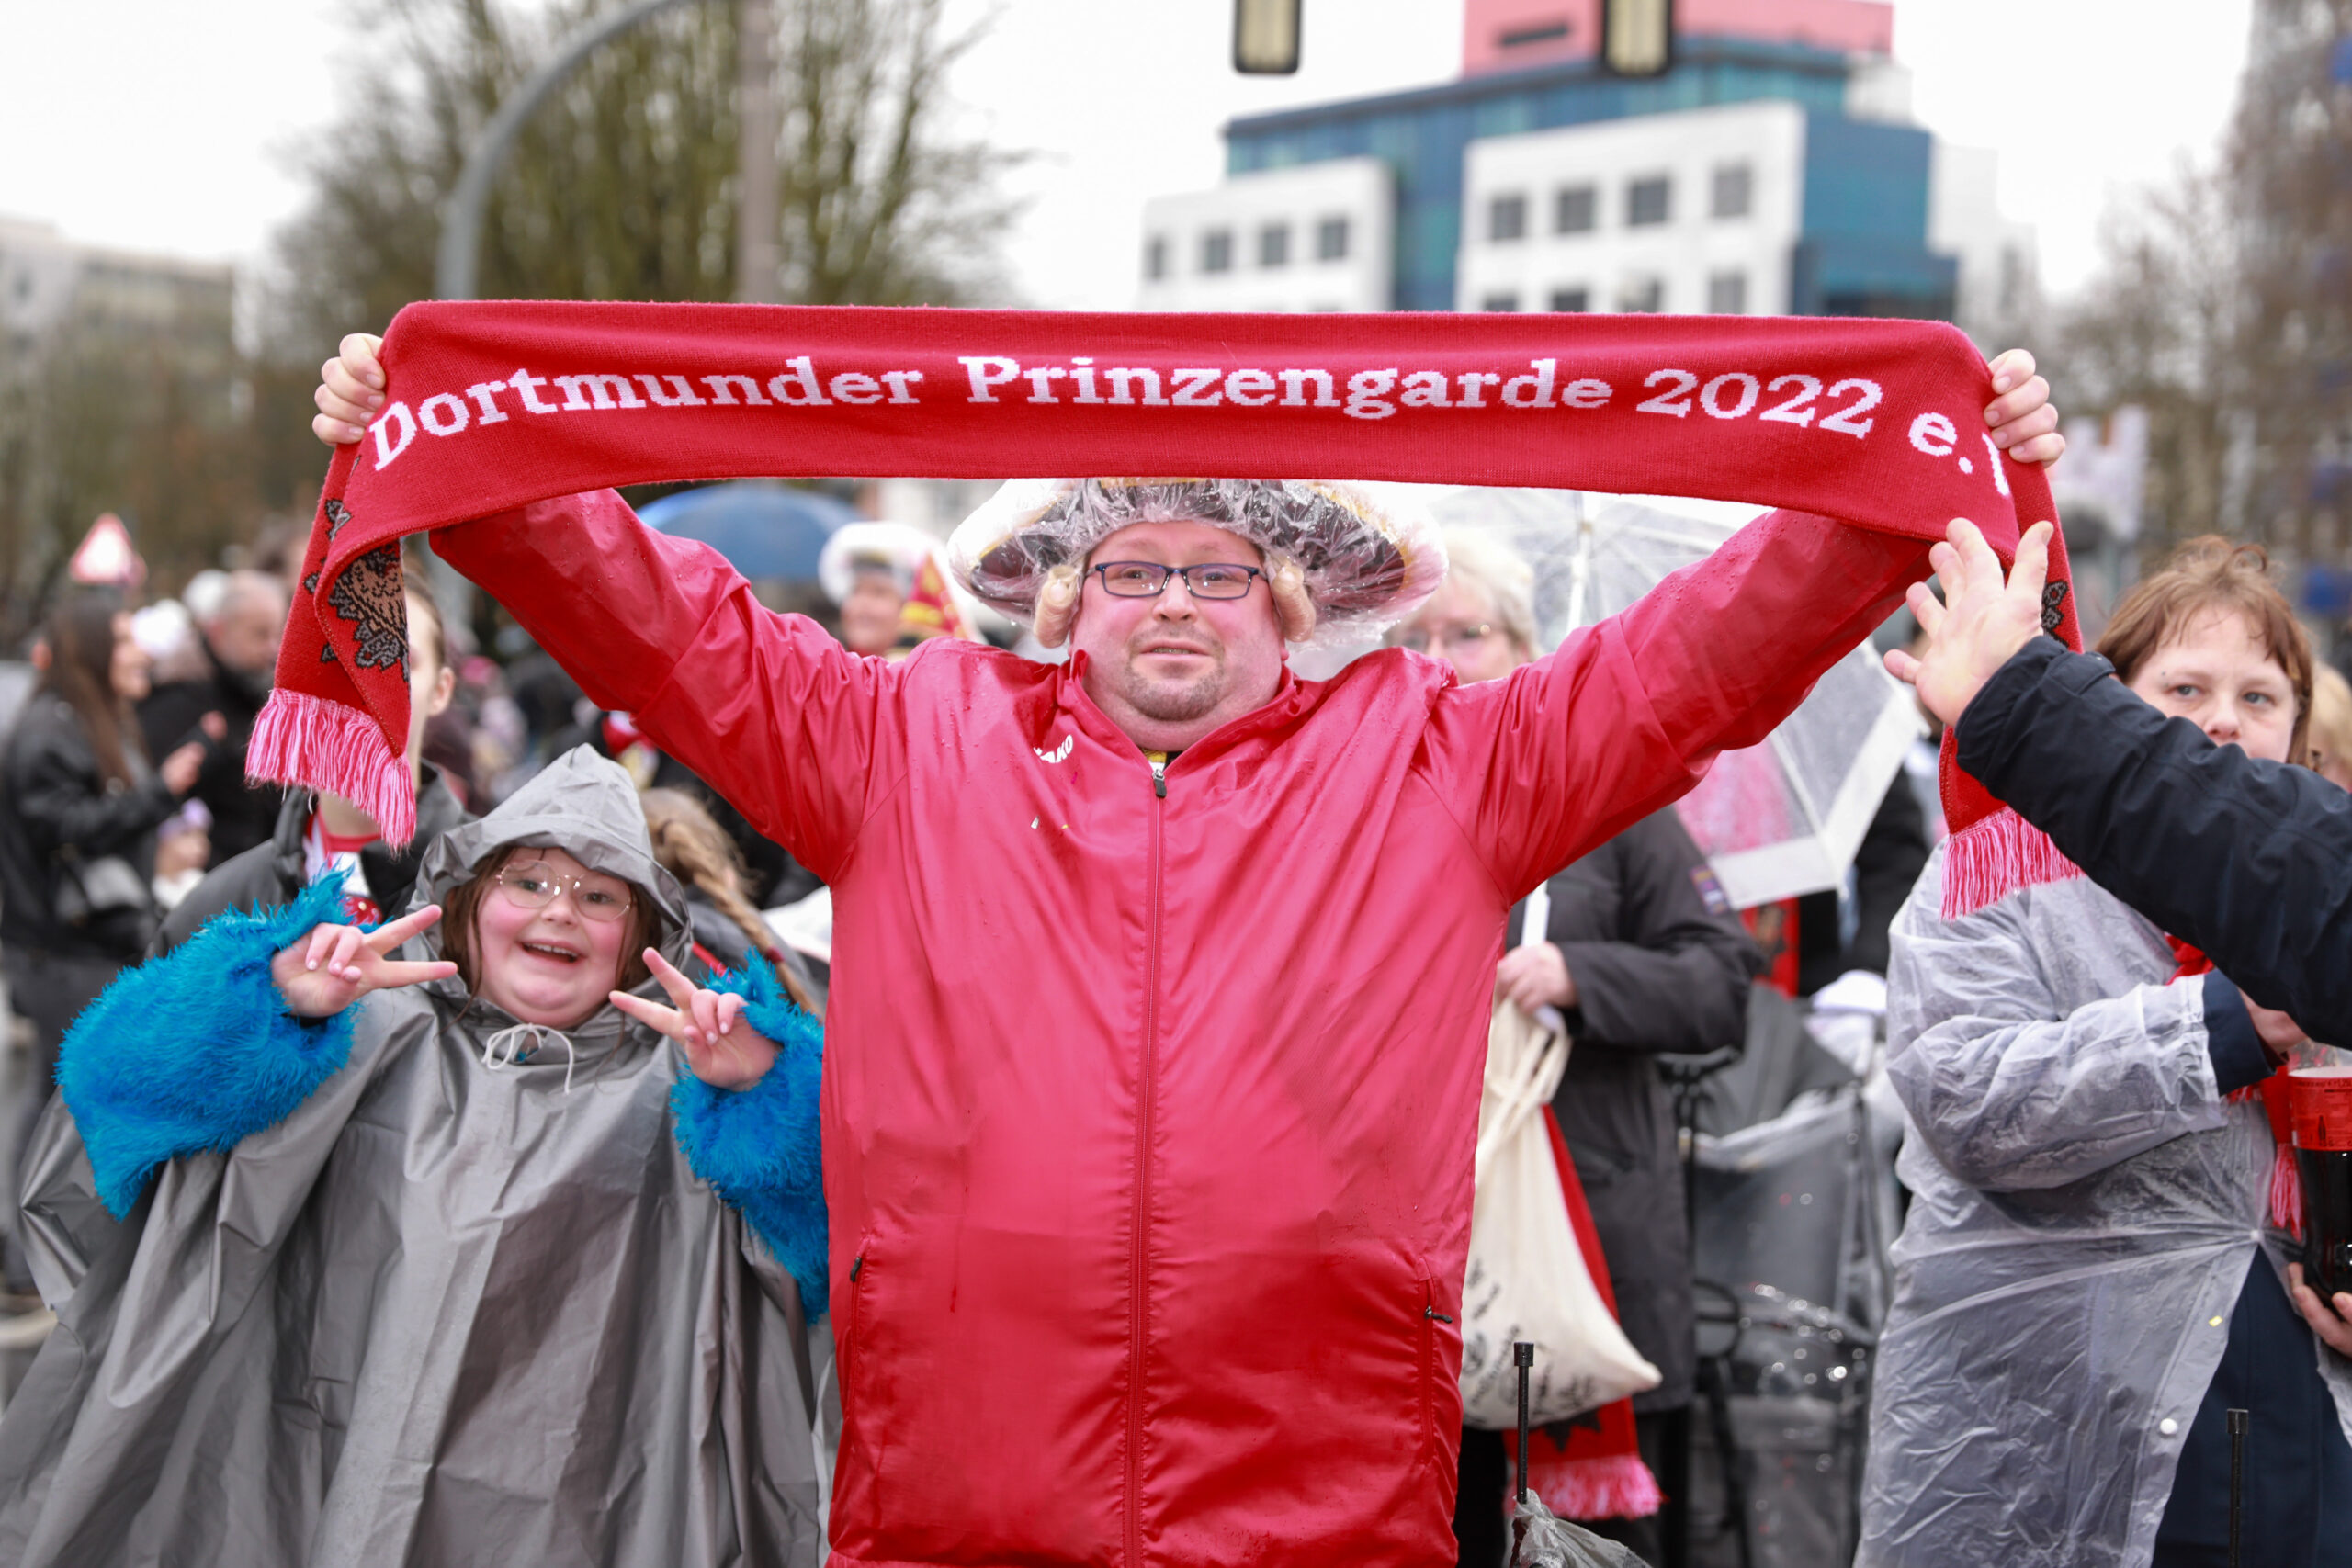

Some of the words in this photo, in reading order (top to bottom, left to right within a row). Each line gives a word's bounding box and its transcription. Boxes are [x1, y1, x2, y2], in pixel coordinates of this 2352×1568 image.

[368, 355, 923, 471] Dortmunder
[957, 355, 1612, 419] Prinzengarde
[1636, 368, 1883, 439] 2022
